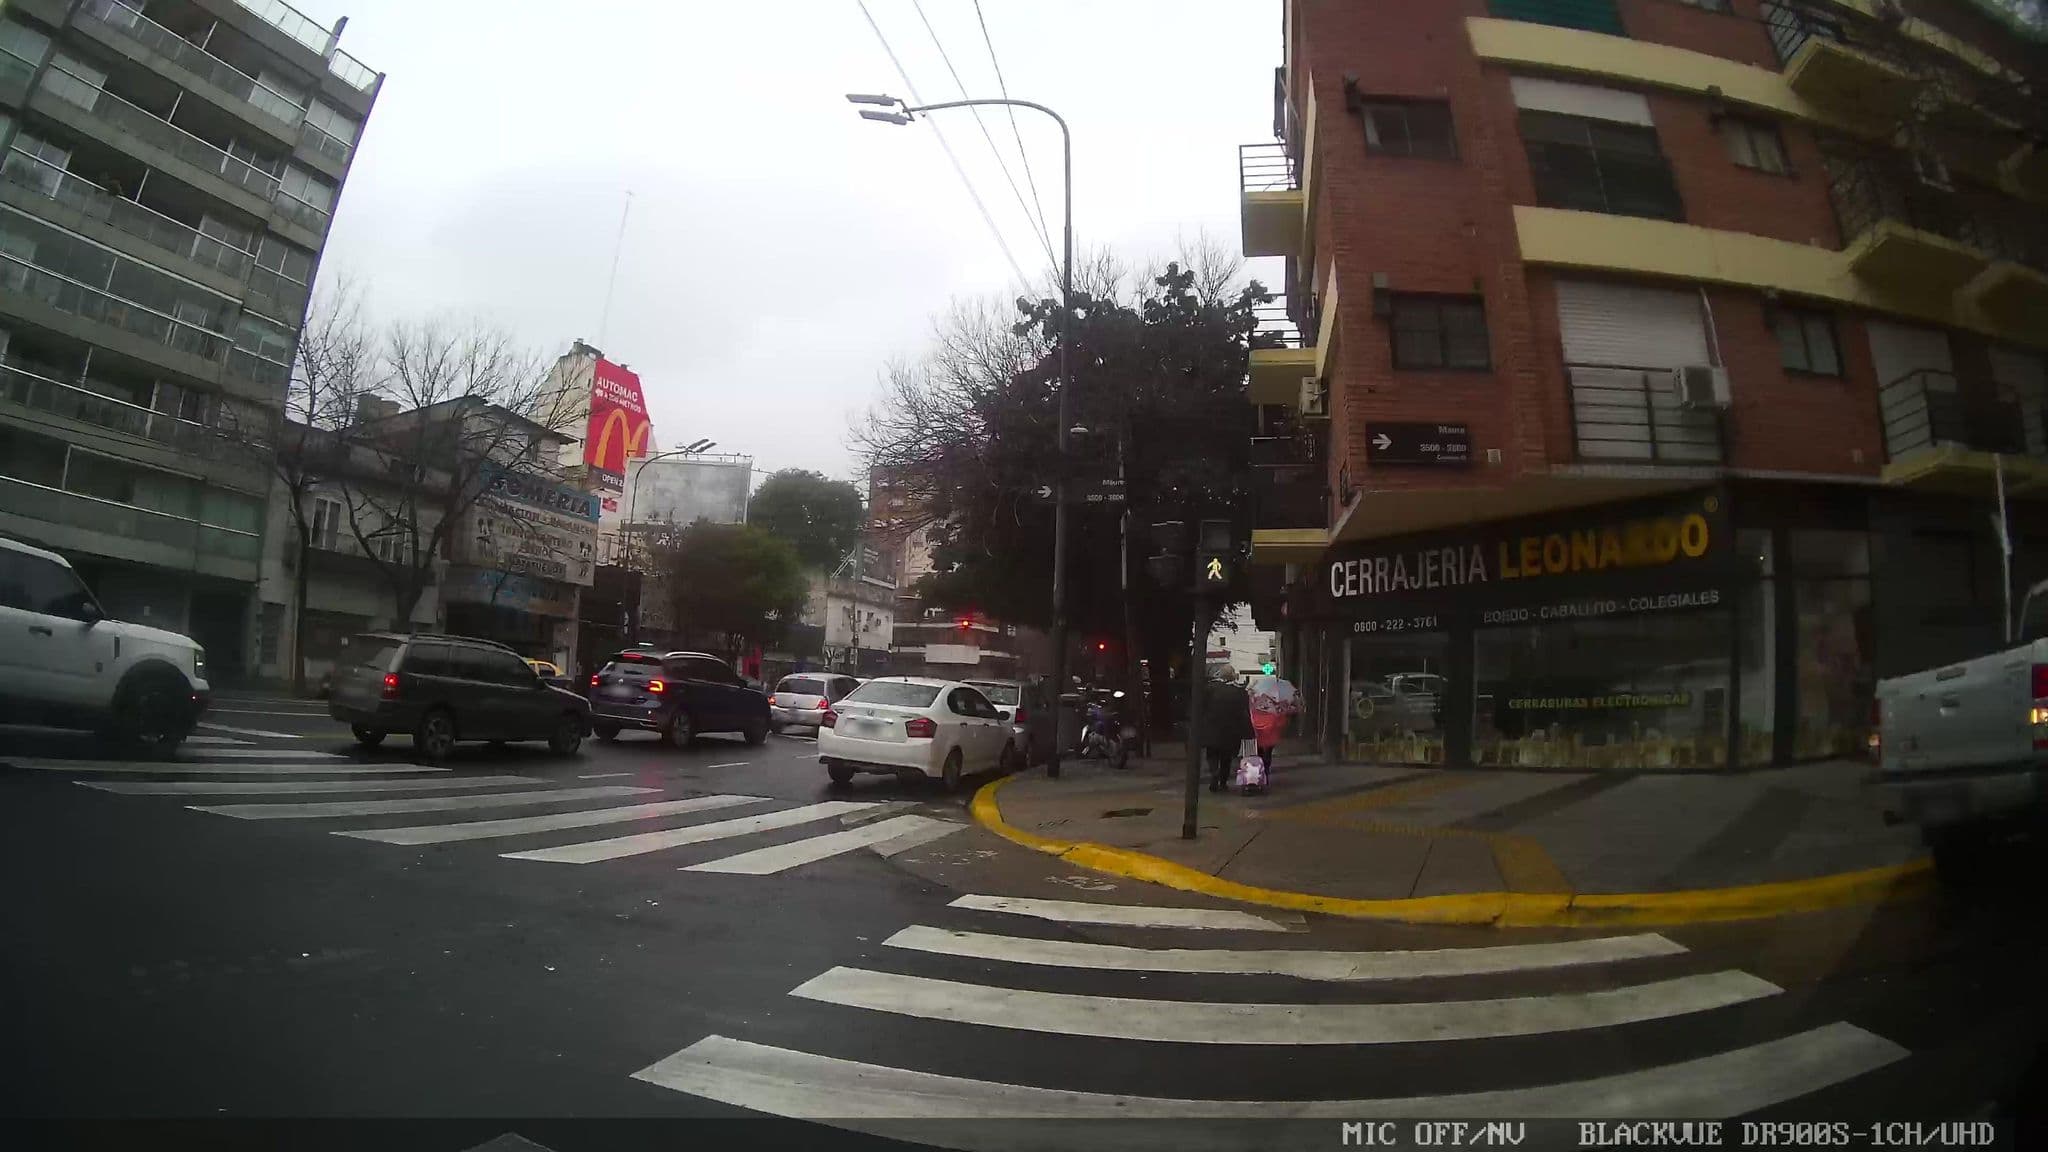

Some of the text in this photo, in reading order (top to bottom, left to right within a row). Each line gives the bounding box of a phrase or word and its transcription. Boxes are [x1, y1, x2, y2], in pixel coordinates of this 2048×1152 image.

[597, 376, 638, 402] AUTOMAC
[602, 474, 619, 486] OPEN
[1330, 513, 1709, 598] CERRAJERIA LEONARDO
[1630, 589, 1720, 611] COLEGIALES
[1354, 621, 1377, 633] 0800
[1386, 618, 1404, 630] 222
